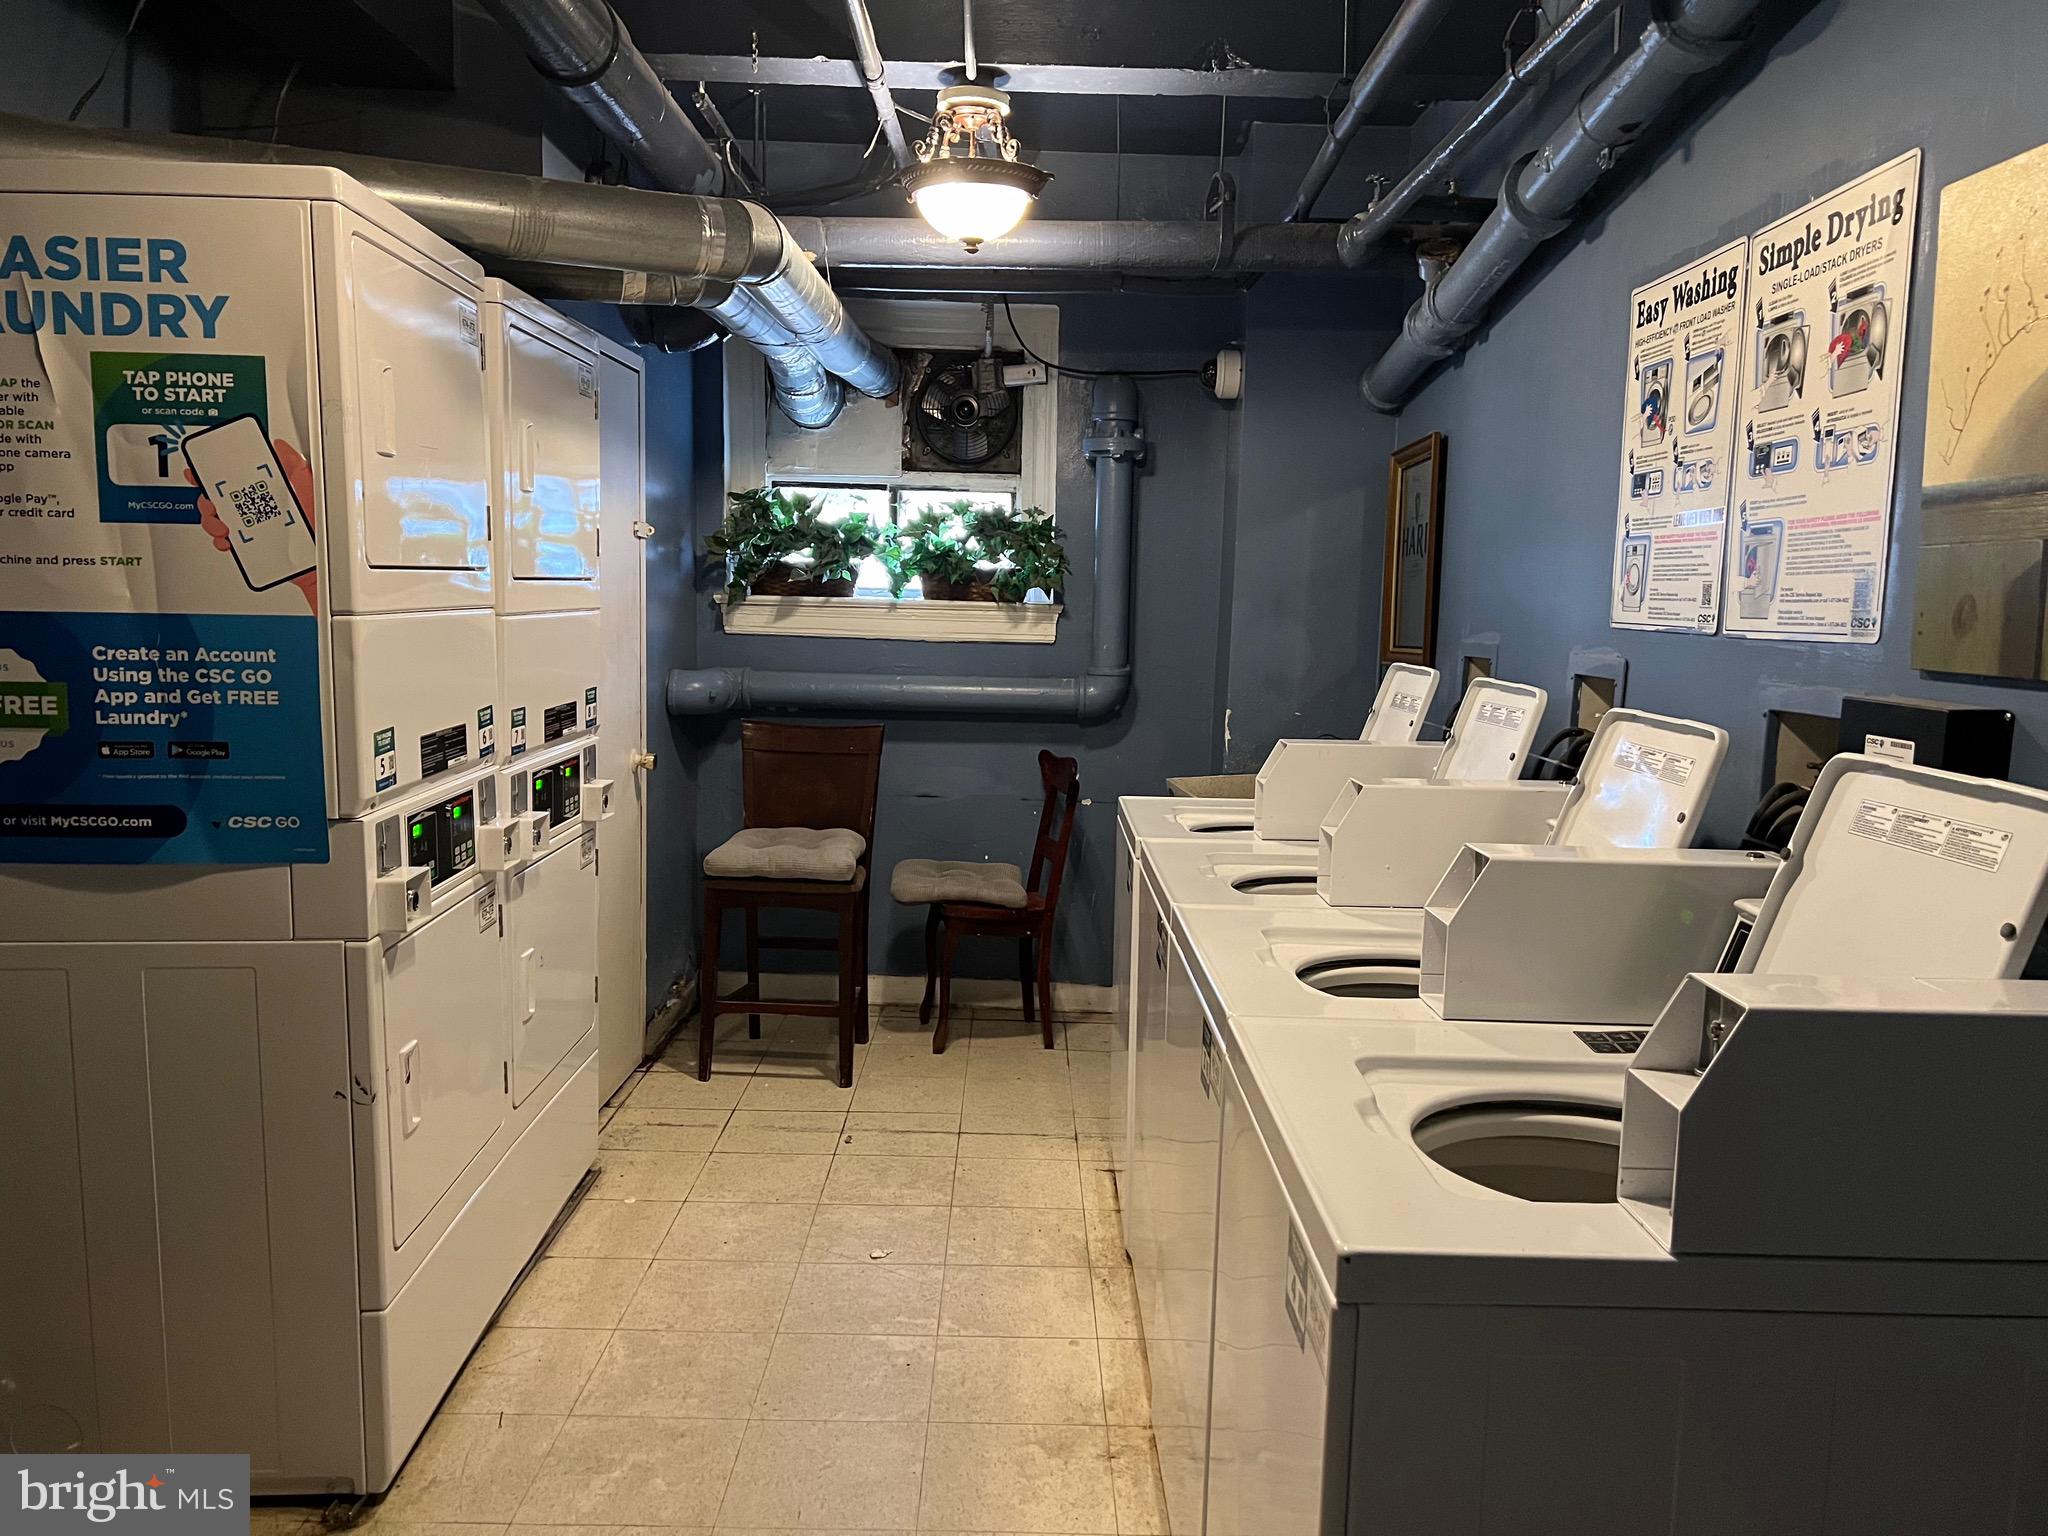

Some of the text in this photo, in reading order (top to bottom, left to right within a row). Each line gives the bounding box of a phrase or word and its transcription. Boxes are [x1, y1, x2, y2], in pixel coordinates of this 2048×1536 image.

[1758, 221, 1822, 276] Simple
[1826, 186, 1906, 245] Drying
[1771, 252, 1848, 294] SINGLE-LOAD/STACK
[1849, 237, 1883, 262] DRYERS
[1636, 297, 1669, 329] Easy
[1672, 264, 1739, 314] Washing
[0, 290, 230, 339] UNDRY
[1680, 316, 1696, 331] FRONT
[1696, 310, 1711, 325] LOAD
[1712, 301, 1736, 317] WASHER
[21, 378, 40, 388] the
[123, 370, 234, 387] TAP PHONE
[13, 392, 39, 402] with
[132, 387, 227, 403] TO START
[142, 407, 204, 416] or scan code
[18, 420, 54, 430] SCAN
[15, 434, 42, 444] with
[24, 449, 71, 459] camera
[8, 507, 43, 517] credit
[47, 507, 75, 518] card
[128, 501, 194, 511] MyCSCGO.com
[36, 555, 59, 565] and
[63, 557, 96, 567] press
[100, 556, 143, 567] START
[1850, 617, 1871, 629] CSC
[92, 645, 276, 663] Create an Account
[92, 667, 272, 684] Using the CSC GO
[94, 688, 280, 706] App and Get FREE
[482, 730, 487, 745] 6
[514, 729, 519, 743] 7
[113, 748, 151, 756] App Store
[186, 748, 226, 757] Google Play
[380, 758, 386, 776] 5
[3, 815, 152, 828] or visit MyCSCGO.com
[228, 816, 300, 829] CSC GO
